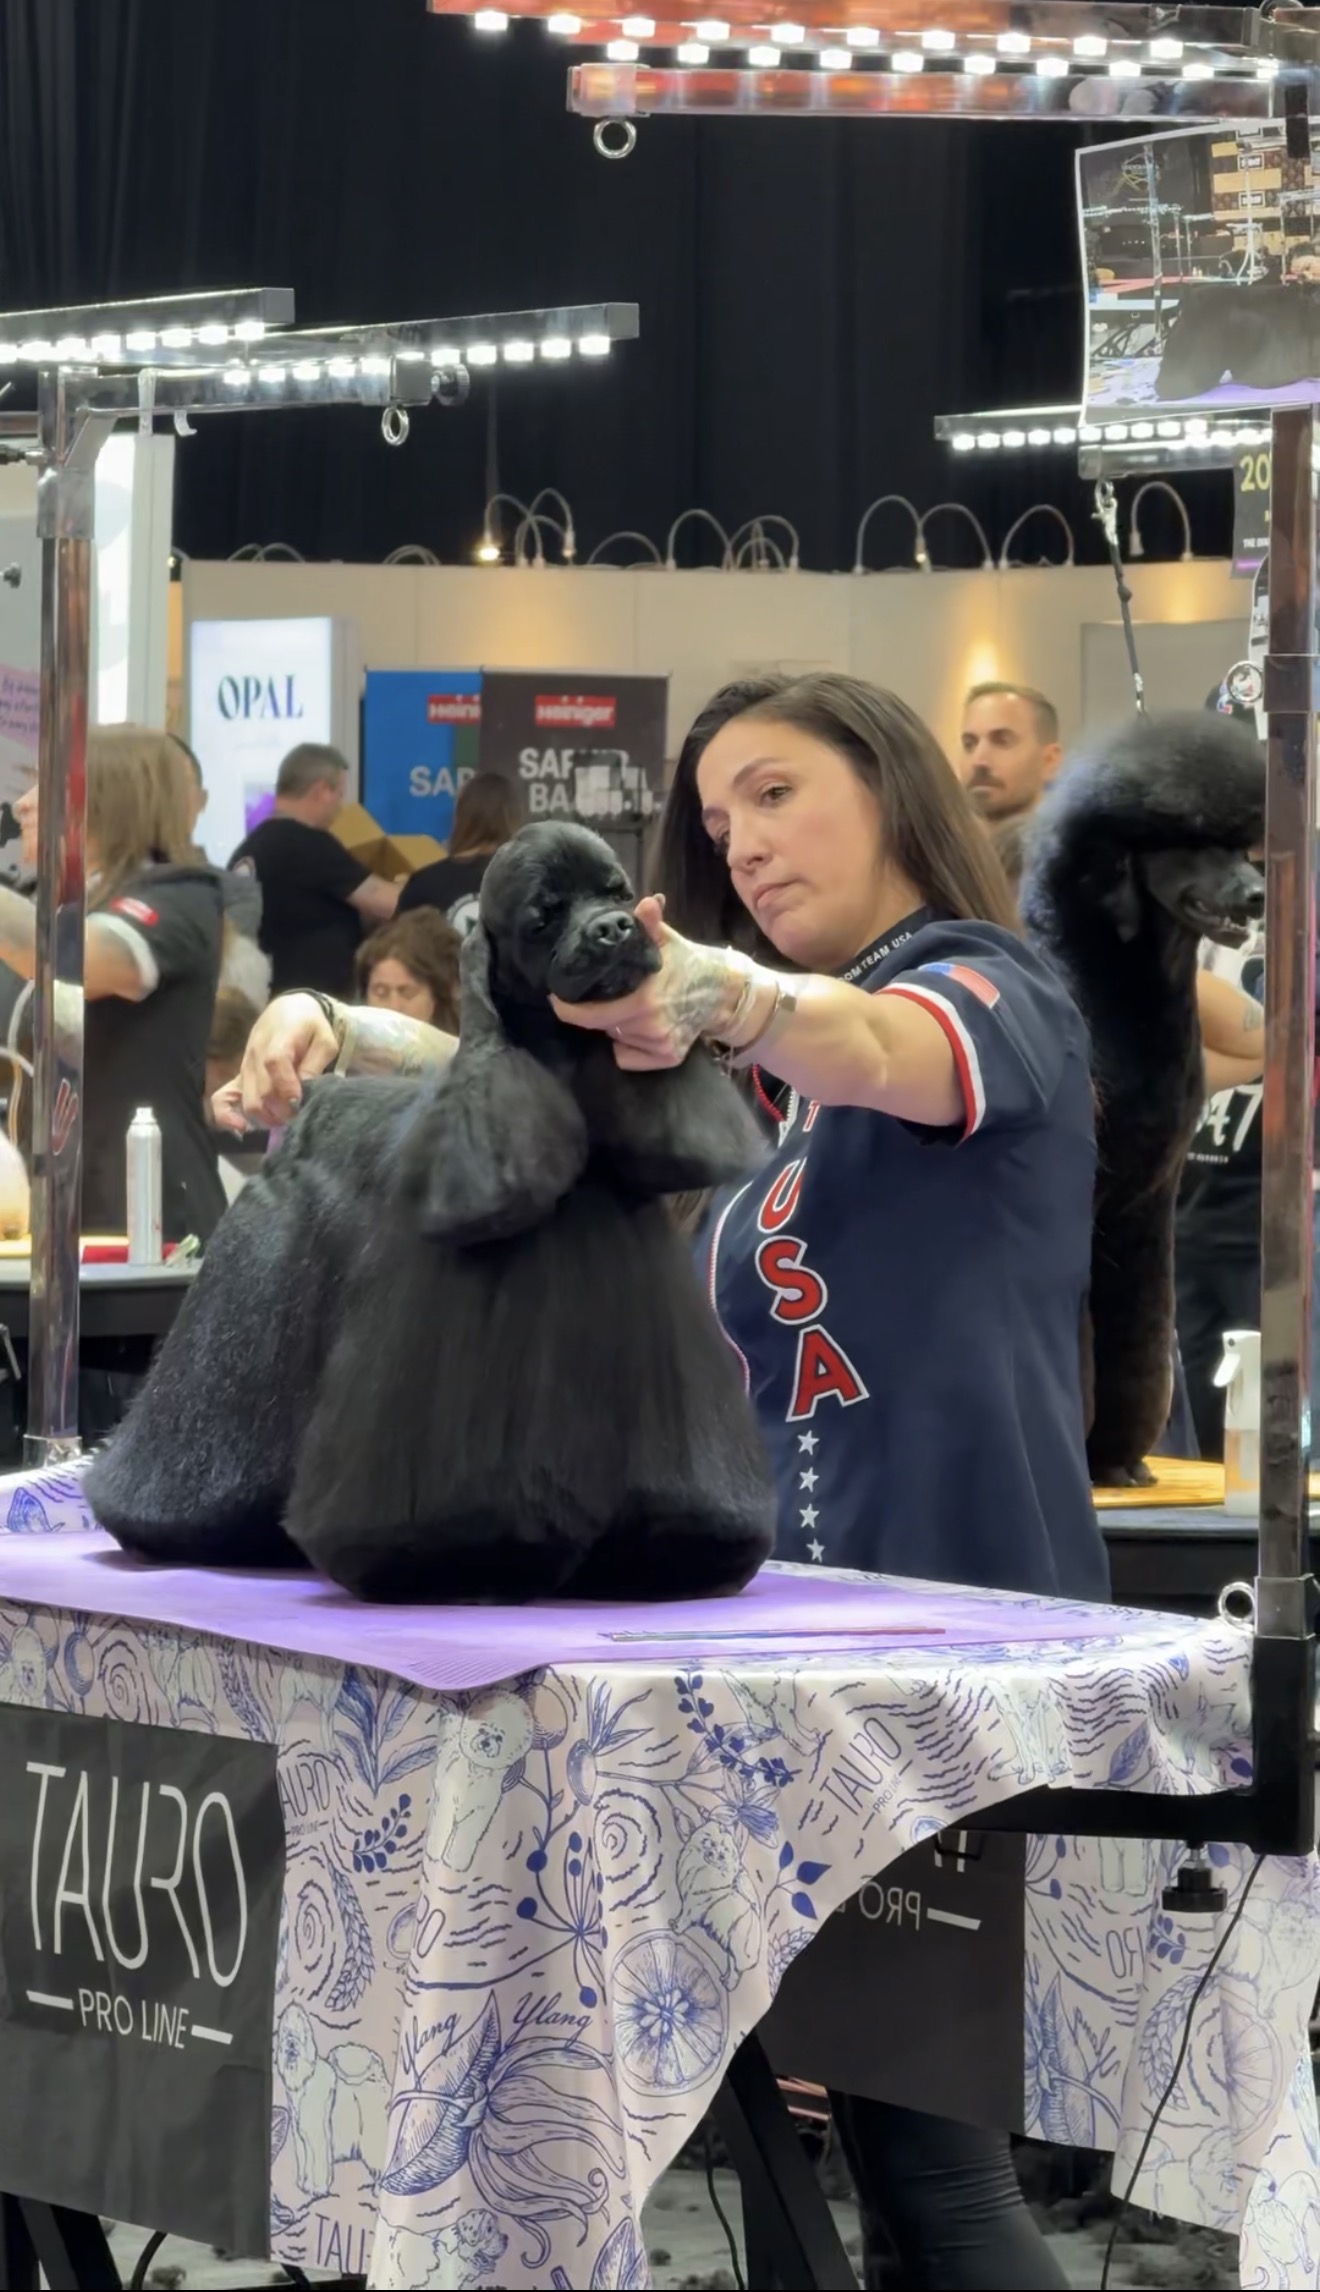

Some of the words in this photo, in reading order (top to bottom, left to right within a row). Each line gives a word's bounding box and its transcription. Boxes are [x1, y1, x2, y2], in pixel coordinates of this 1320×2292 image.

[217, 674, 304, 720] OPAL
[861, 944, 890, 969] TEAM
[891, 931, 913, 949] USA
[755, 1156, 870, 1422] USA
[276, 1759, 331, 1818] AURO
[819, 1717, 901, 1816] TAURO
[26, 1761, 247, 1987] TAURO
[78, 1988, 133, 2035] PRO
[142, 2000, 189, 2049] LINE
